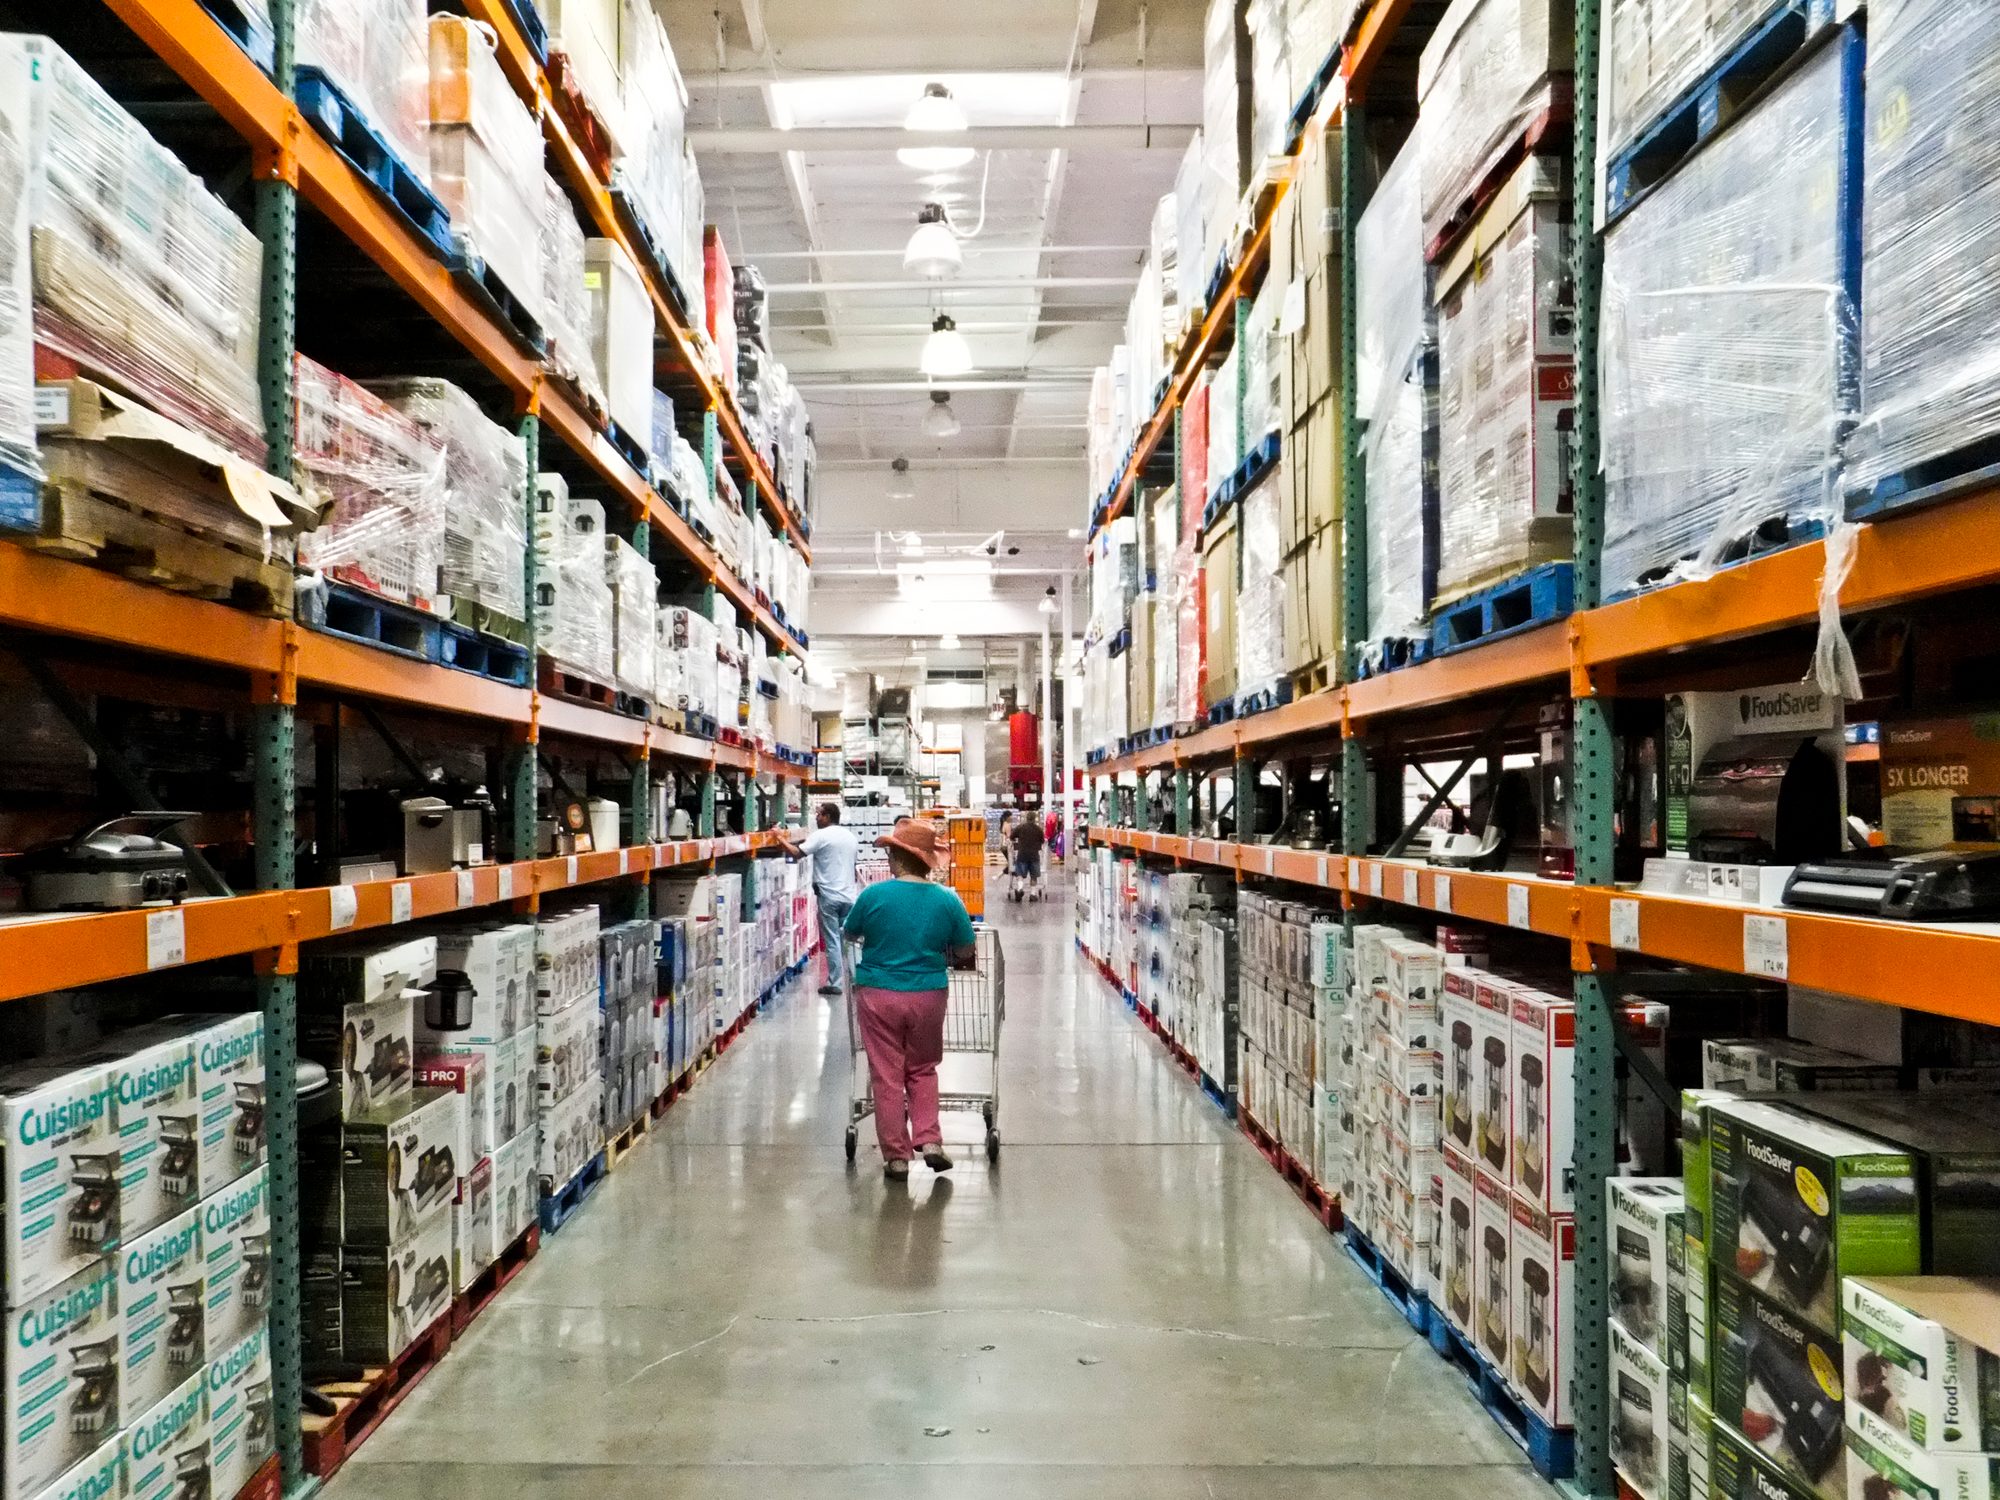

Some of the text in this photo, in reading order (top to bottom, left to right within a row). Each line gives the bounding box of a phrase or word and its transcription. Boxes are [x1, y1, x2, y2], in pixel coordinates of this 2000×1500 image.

[1558, 371, 1573, 390] S
[1752, 693, 1823, 718] FoodSaver
[1890, 730, 1932, 743] FoodSaver
[1909, 765, 1969, 786] LONGER
[1324, 931, 1334, 985] Cuisinart
[200, 1027, 265, 1073] Cuisinart
[1714, 1048, 1752, 1072] FoodSaver
[118, 1055, 196, 1105] Cuisinart
[431, 1070, 457, 1081] PRO
[19, 1083, 119, 1147] Cuisinart
[1746, 1137, 1792, 1174] FoodSaver
[205, 1175, 269, 1234] Cuisinart
[1619, 1191, 1658, 1231] FoodSaver
[126, 1217, 201, 1285] Cuisinart
[18, 1269, 118, 1349] Cuisinart
[1756, 1301, 1805, 1345] FoodSaver
[1861, 1298, 1905, 1334] FoodSaver
[209, 1325, 268, 1392] Cuisinart
[1620, 1336, 1660, 1385] FoodSaver
[1944, 1340, 1959, 1425] FoodSaver
[132, 1377, 209, 1461] Cuisinart
[1866, 1419, 1914, 1461] FoodSaver
